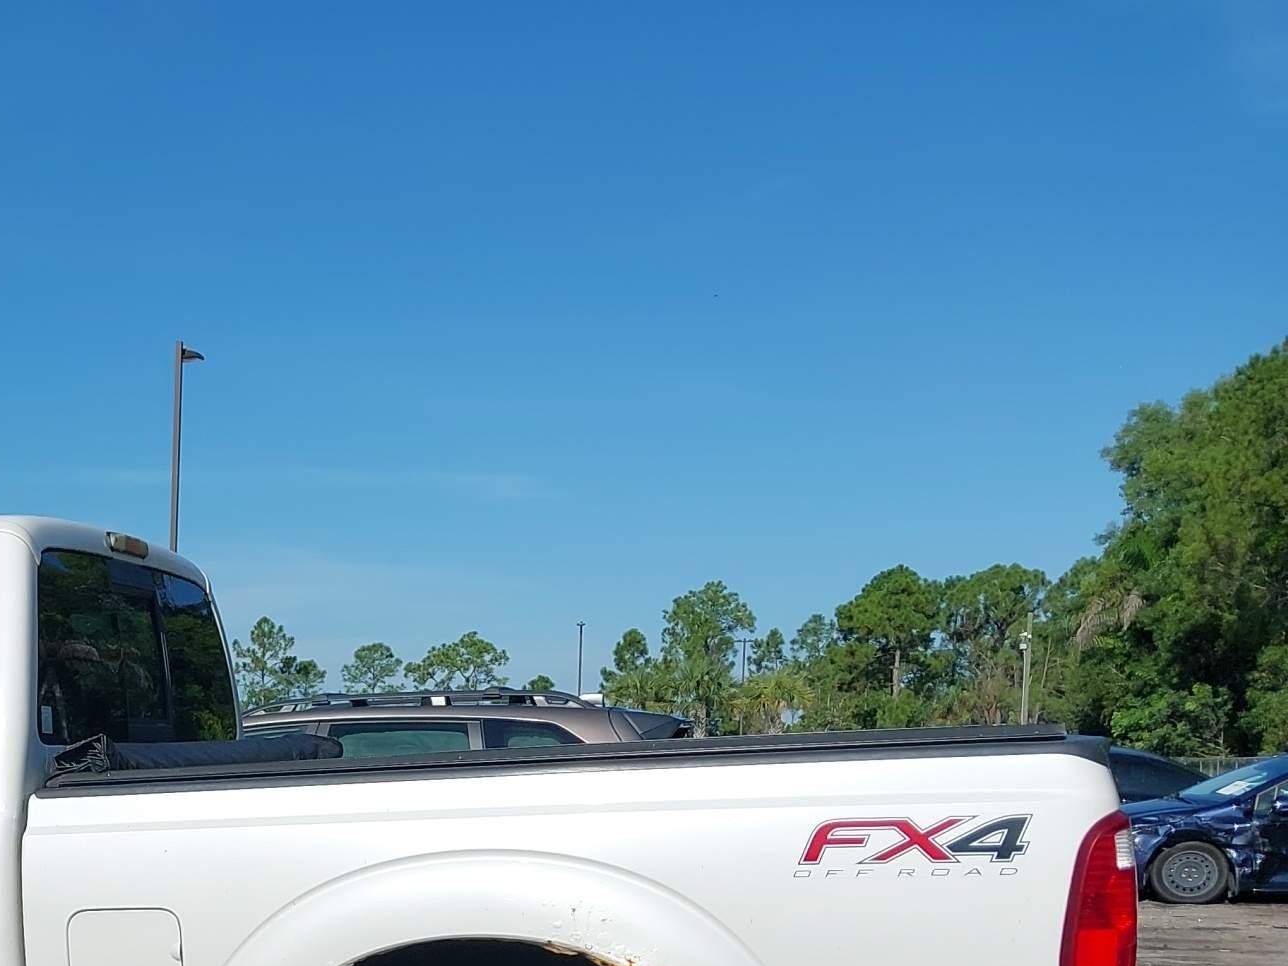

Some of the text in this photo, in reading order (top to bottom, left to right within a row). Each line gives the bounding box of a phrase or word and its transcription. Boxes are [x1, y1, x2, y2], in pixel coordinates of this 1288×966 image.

[798, 814, 1033, 865] FX4
[793, 867, 1019, 879] OFF ROAD
